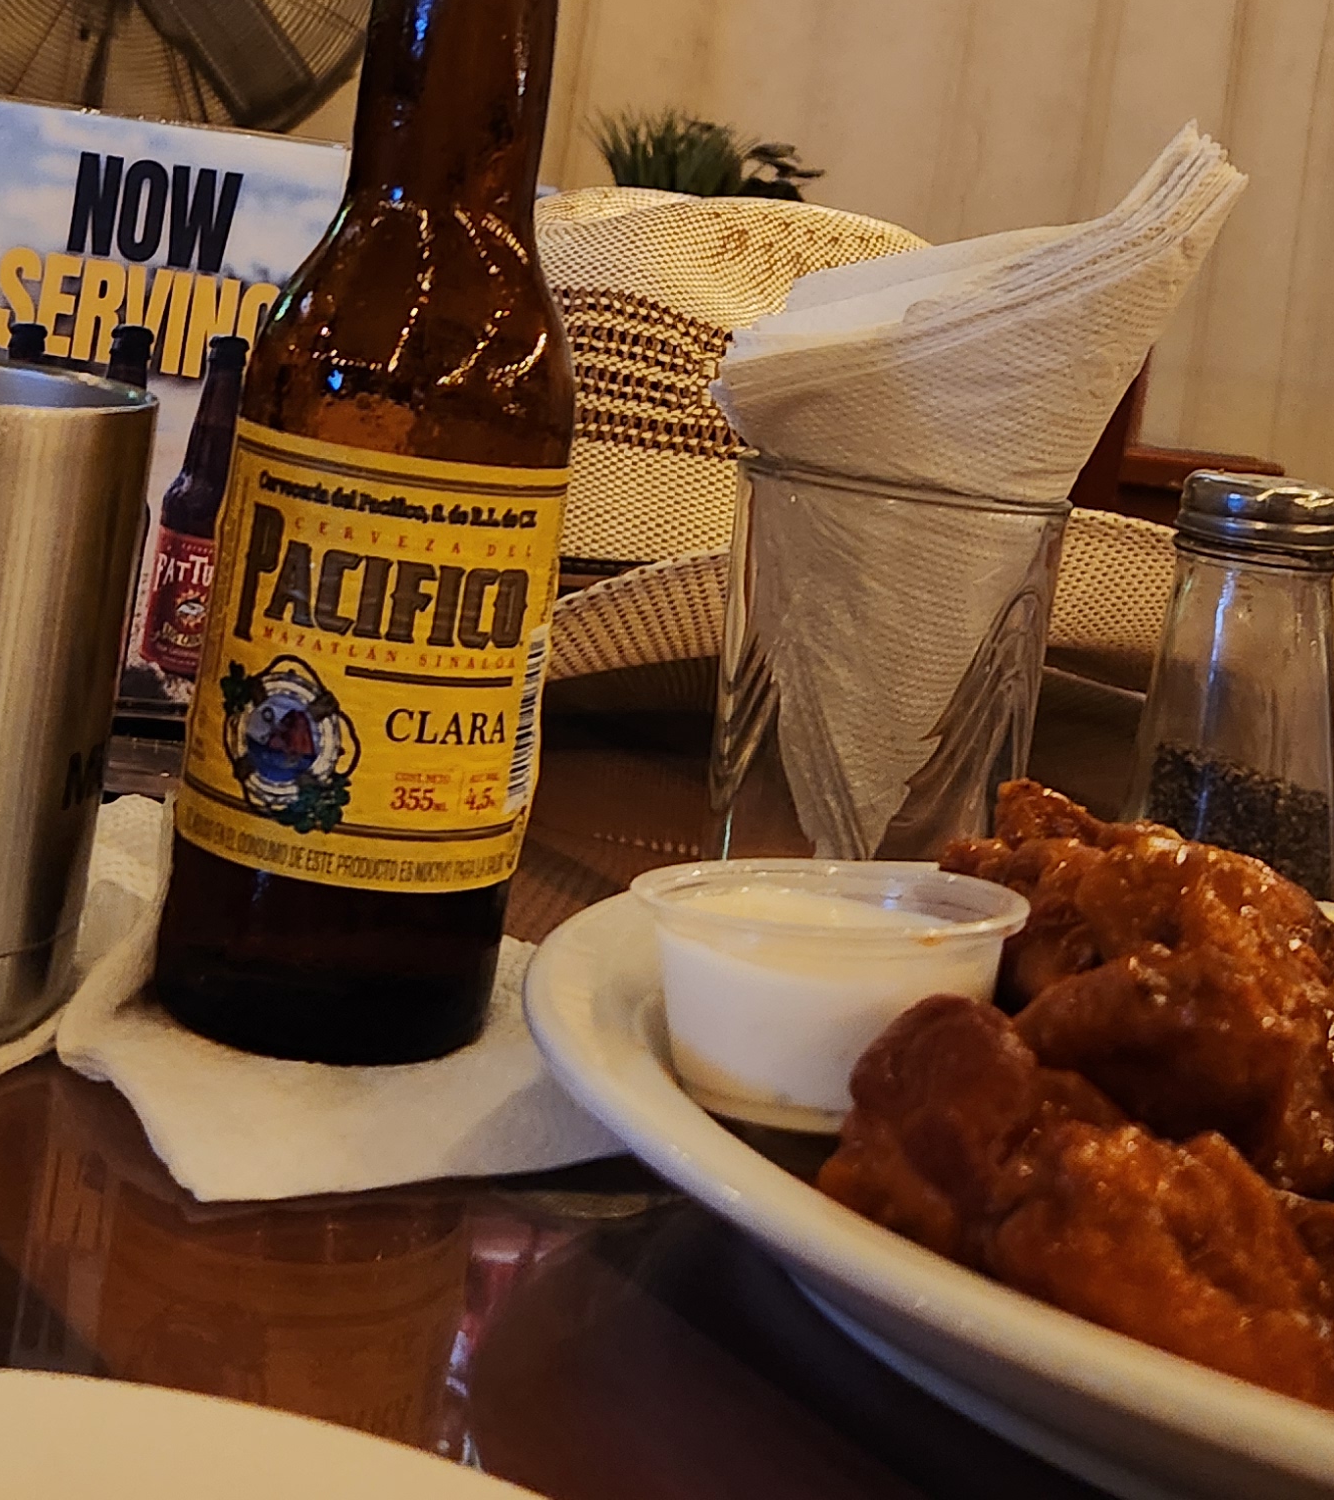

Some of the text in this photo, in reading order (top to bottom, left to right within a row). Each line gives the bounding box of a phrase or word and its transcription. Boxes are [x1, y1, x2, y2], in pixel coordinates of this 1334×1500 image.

[67, 151, 244, 273] NOW
[232, 501, 531, 651] PACIFICO
[294, 517, 461, 558] CERVEZA
[384, 707, 507, 746] CLARA
